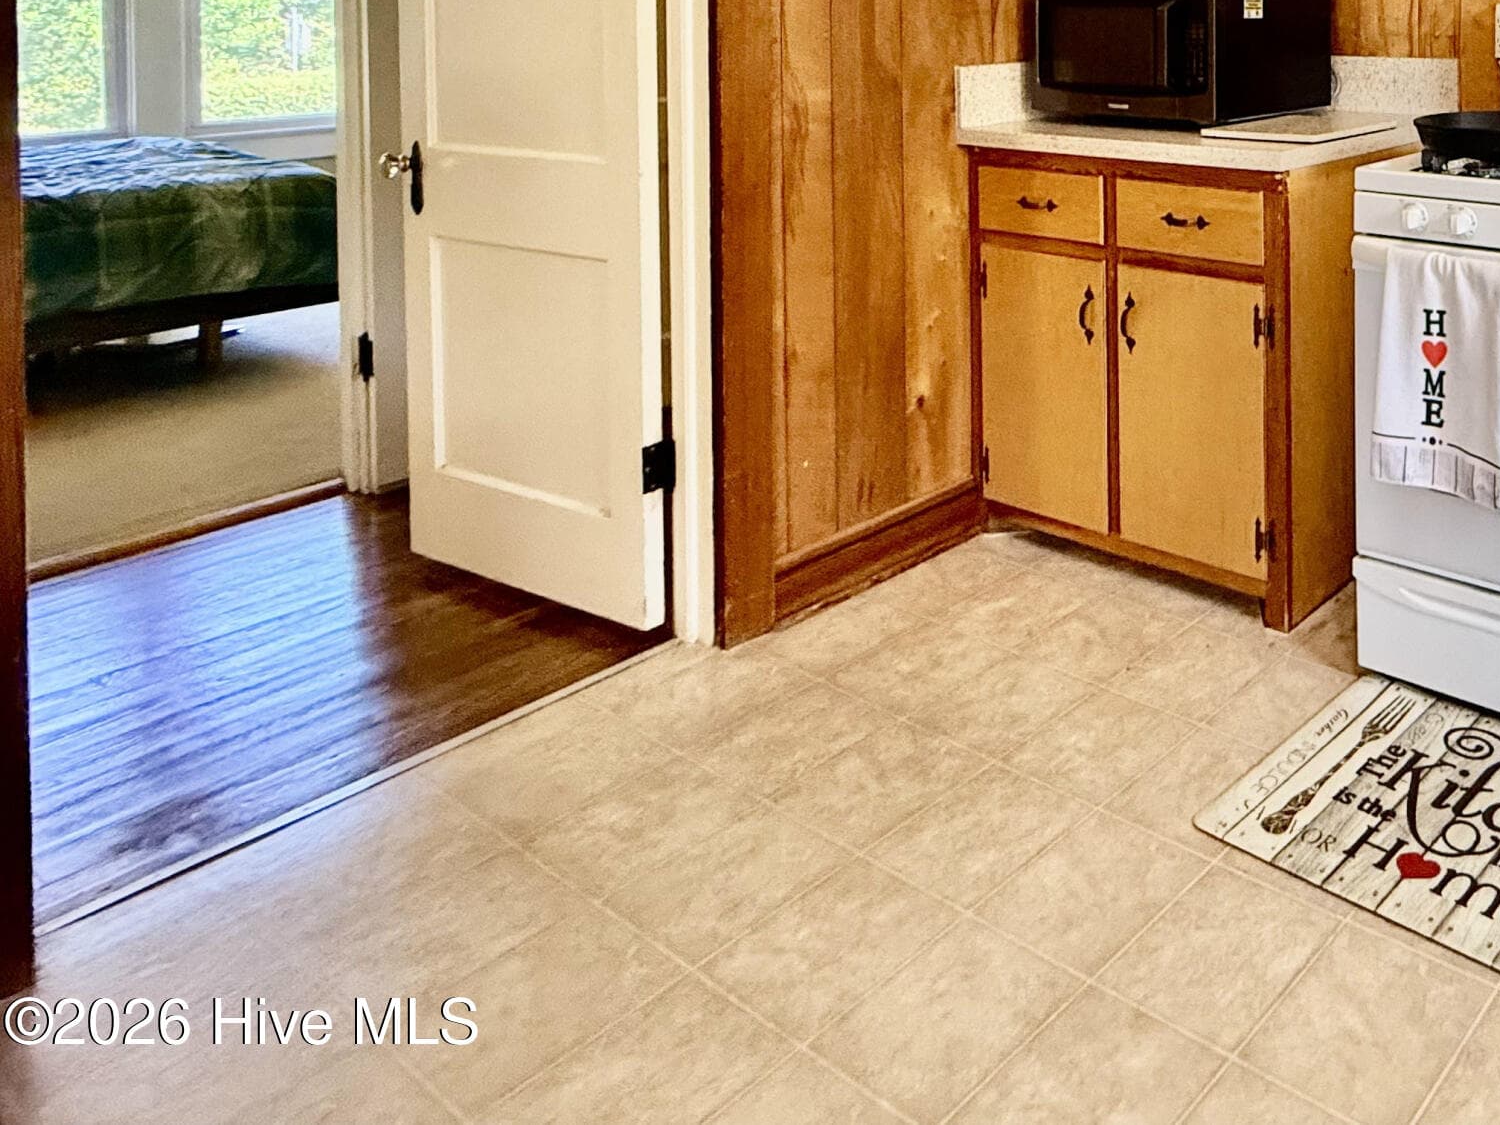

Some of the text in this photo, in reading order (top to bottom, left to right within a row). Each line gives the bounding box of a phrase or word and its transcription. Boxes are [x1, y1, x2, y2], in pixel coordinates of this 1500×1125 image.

[1421, 308, 1448, 429] HME
[1355, 743, 1407, 779] The
[1332, 786, 1357, 805] is
[1357, 796, 1397, 822] the
